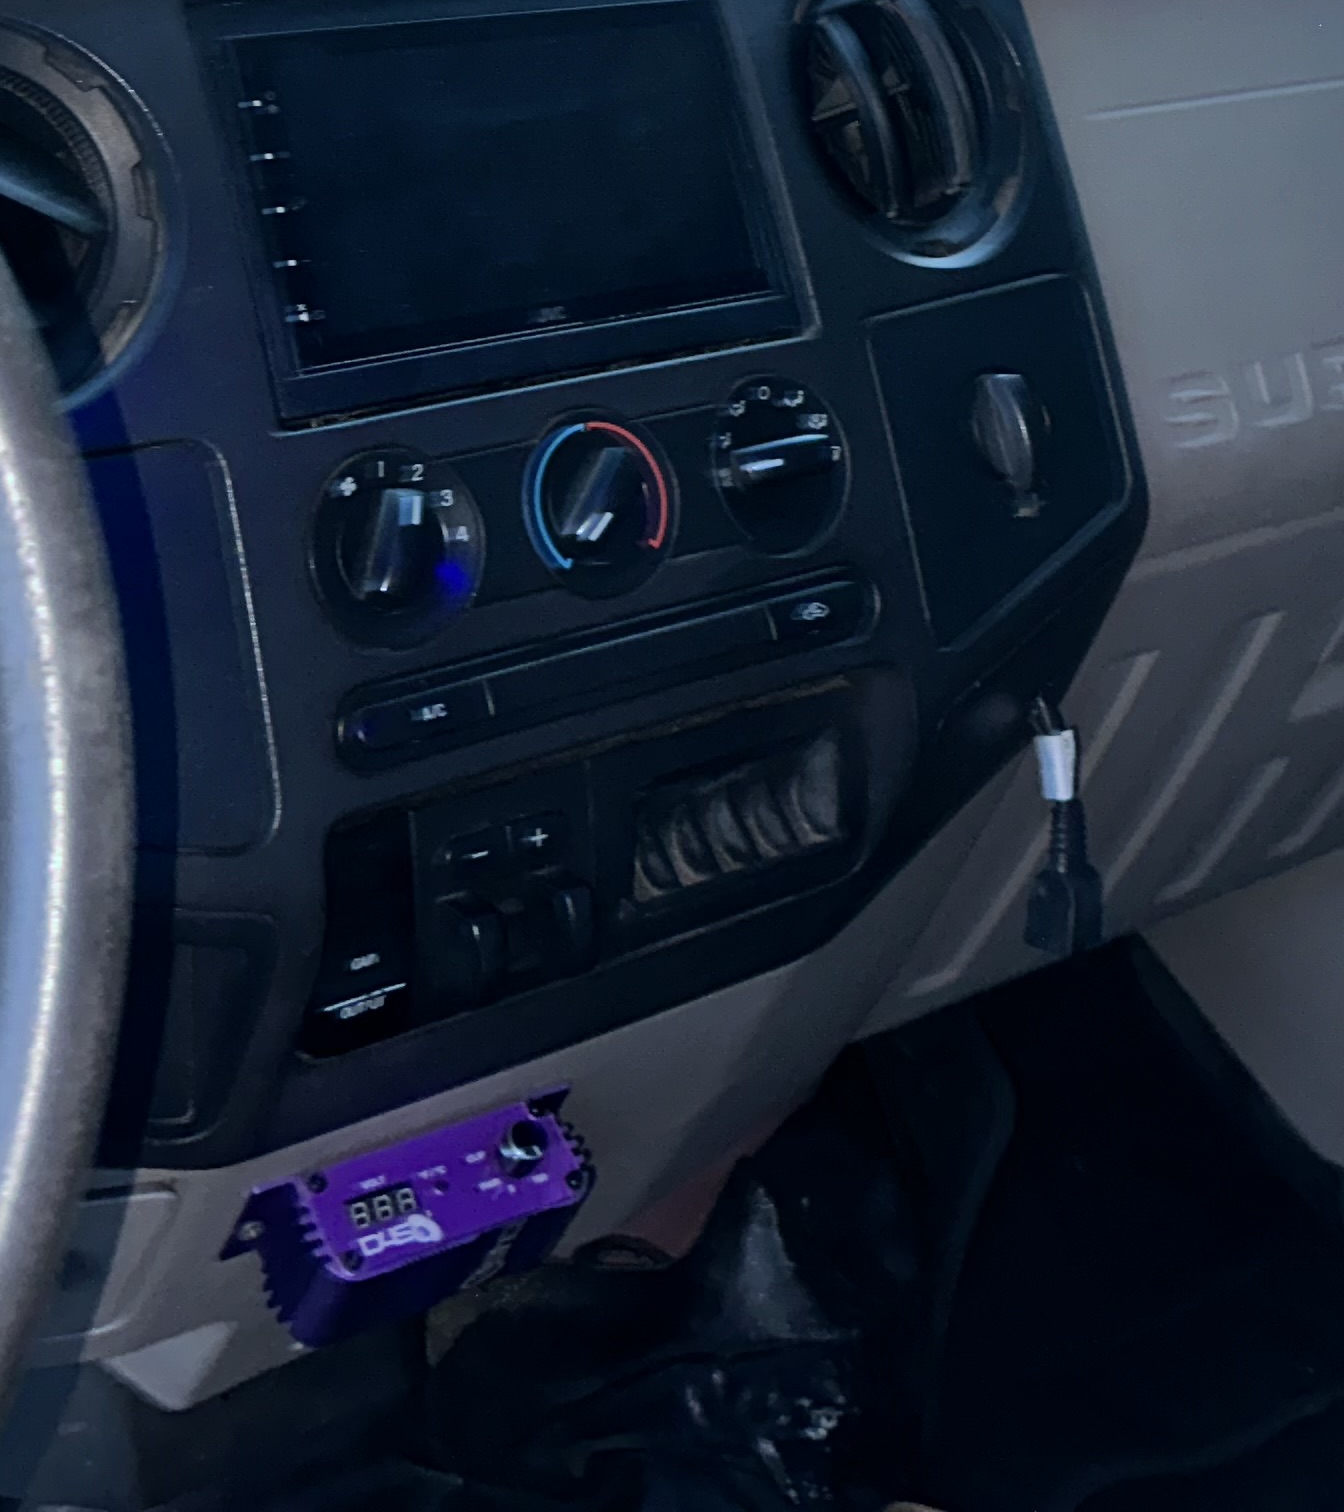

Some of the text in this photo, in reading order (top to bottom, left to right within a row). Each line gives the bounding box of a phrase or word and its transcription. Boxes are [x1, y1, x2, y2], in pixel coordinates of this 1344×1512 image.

[377, 460, 385, 478] 1
[410, 463, 424, 482] 2
[439, 489, 454, 507] 3
[455, 525, 470, 542] 4
